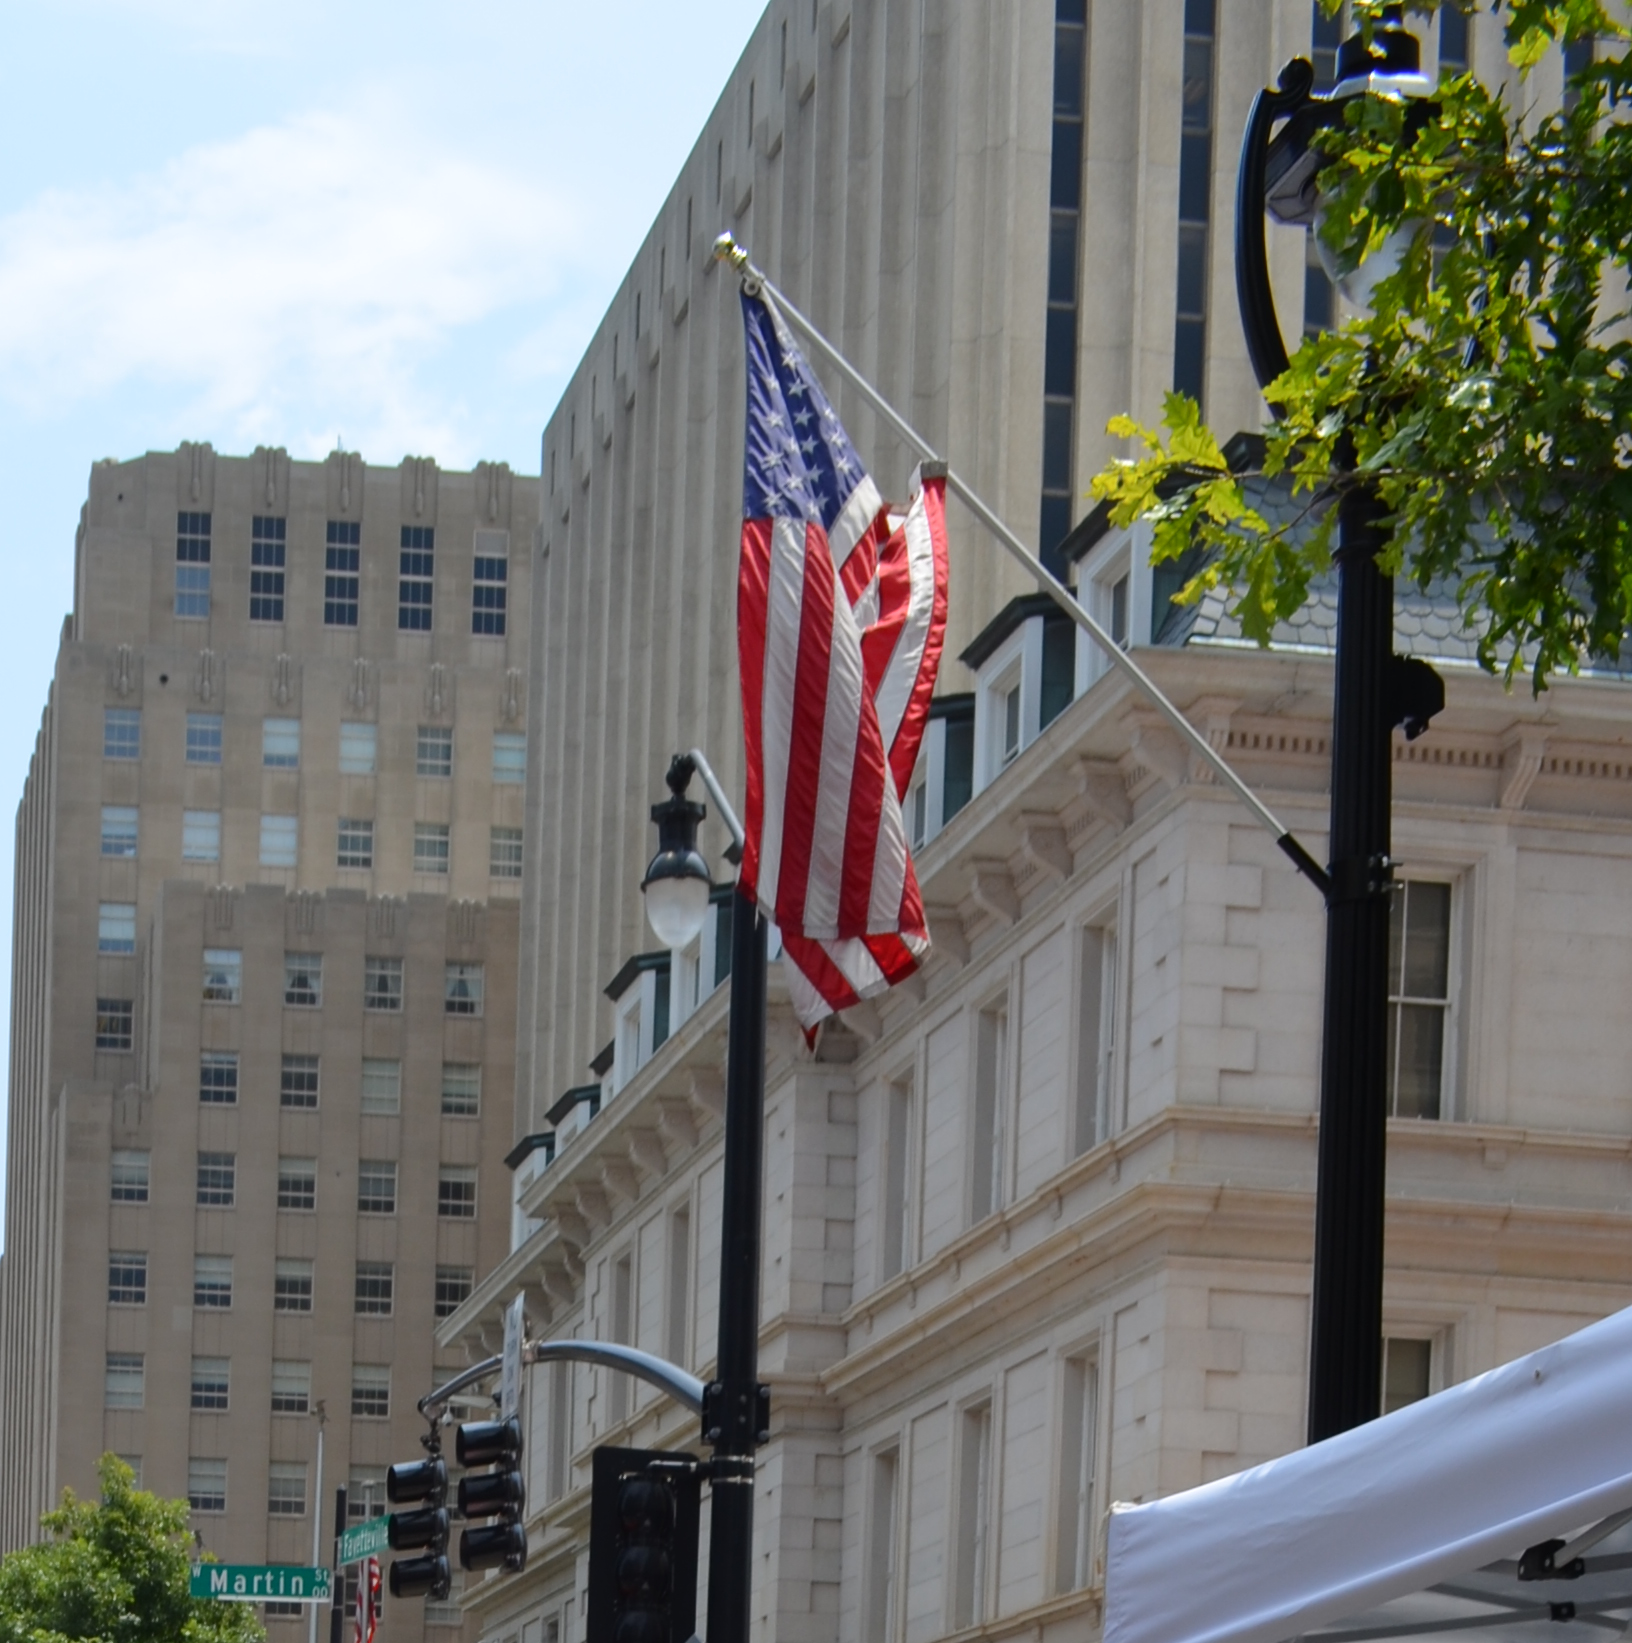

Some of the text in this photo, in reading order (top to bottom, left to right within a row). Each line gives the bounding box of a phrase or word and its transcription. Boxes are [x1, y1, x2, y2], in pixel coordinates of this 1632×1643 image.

[192, 1565, 329, 1595] W Martin St
